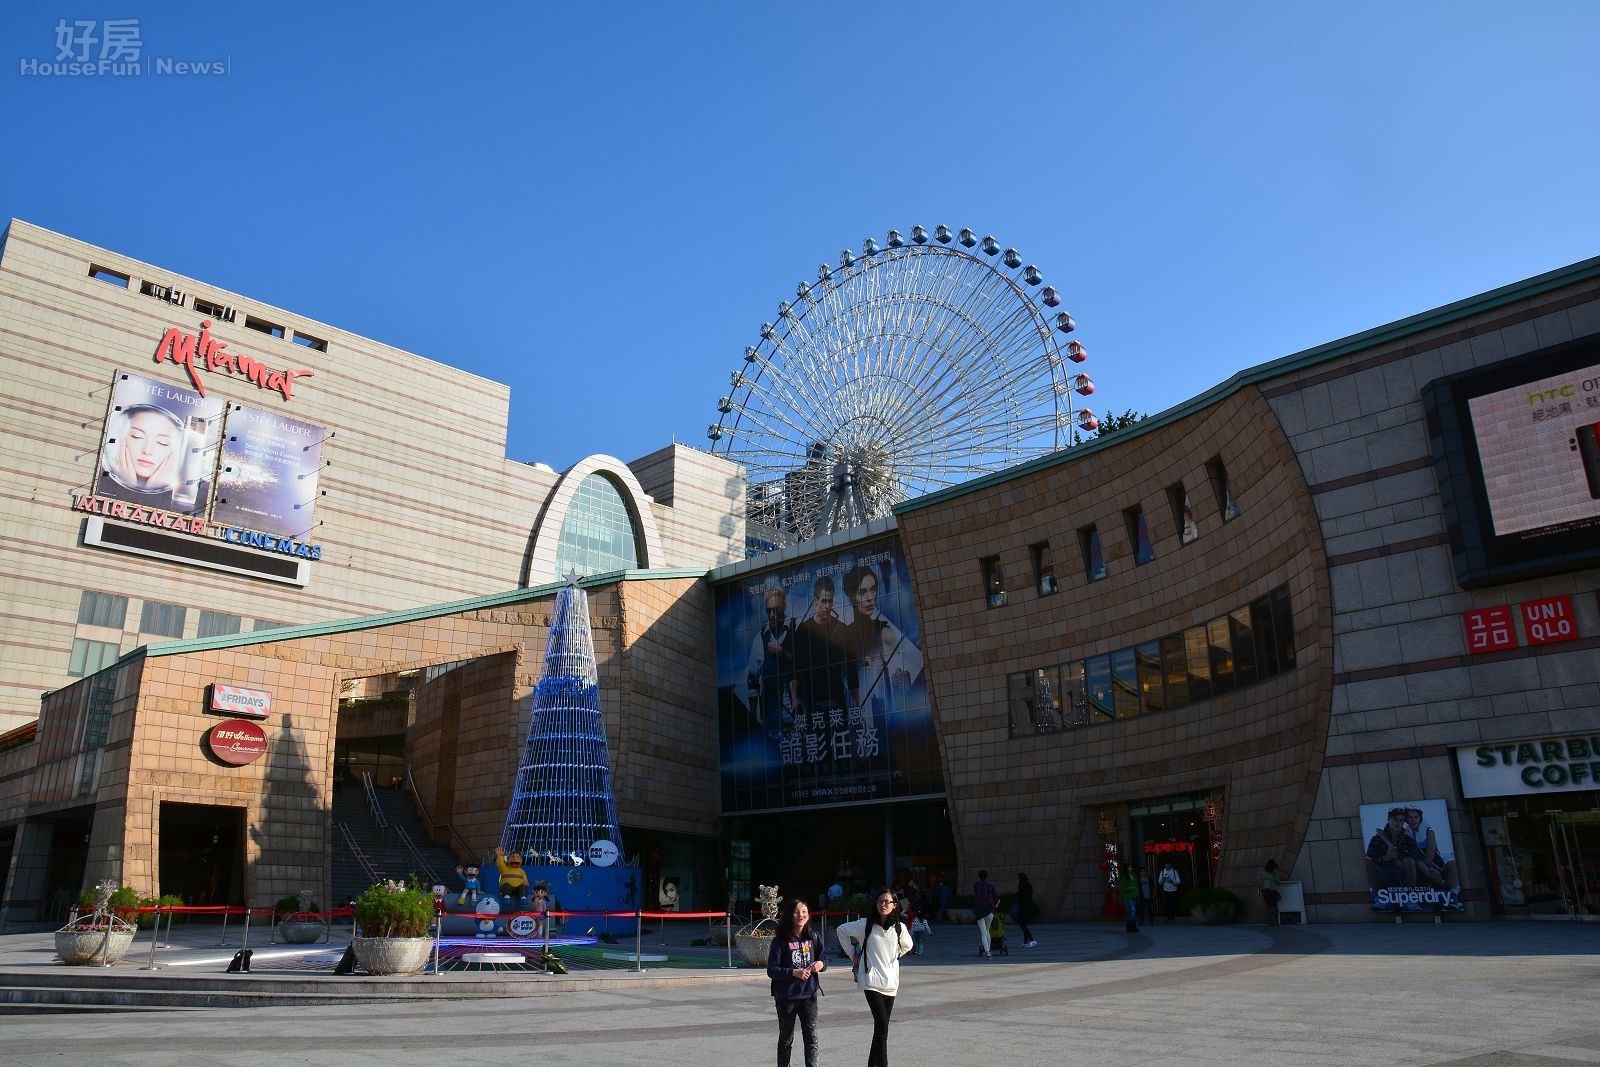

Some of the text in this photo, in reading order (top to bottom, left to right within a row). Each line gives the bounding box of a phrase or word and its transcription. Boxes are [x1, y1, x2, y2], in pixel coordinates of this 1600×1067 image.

[166, 390, 208, 409] LAUDER
[273, 420, 311, 437] LAUDER
[77, 495, 204, 535] MIRAMAR
[226, 527, 322, 559] CINEMAS
[1471, 611, 1506, 630] ユニ
[1526, 602, 1564, 621] UNI
[1473, 629, 1509, 648] クロ
[1531, 620, 1571, 641] QLO
[227, 694, 264, 708] FRIDAYS
[793, 706, 861, 732] 傑克萊恩
[779, 727, 880, 765] 詭影任務
